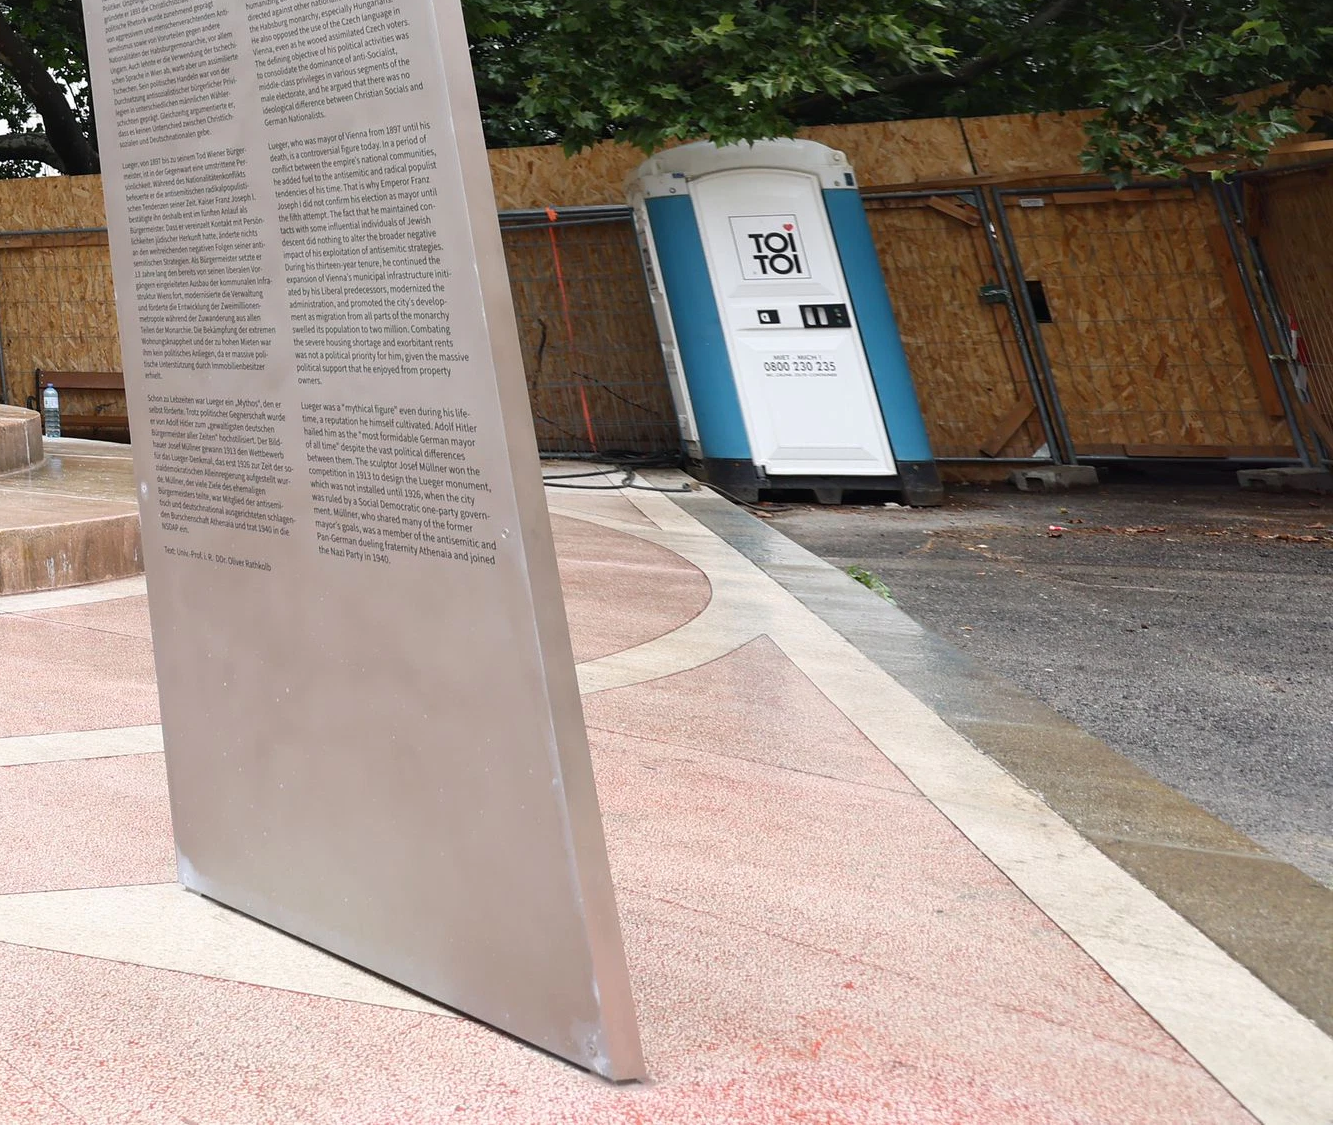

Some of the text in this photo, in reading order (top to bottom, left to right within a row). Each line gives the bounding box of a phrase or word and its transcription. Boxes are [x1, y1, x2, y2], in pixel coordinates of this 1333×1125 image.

[247, 8, 271, 21] directed
[271, 4, 293, 17] against
[293, 1, 310, 11] other
[248, 24, 259, 33] the
[259, 19, 288, 30] Habsburg
[320, 3, 352, 17] especially
[250, 6, 400, 44] He also opposed the use of the Czech language in
[254, 31, 409, 67] The defining objective of his political activities was
[262, 80, 423, 114] ideological difference between Christian Socials and
[271, 164, 293, 173] conflict
[293, 162, 320, 171] between
[321, 159, 332, 168] the
[360, 151, 388, 163] national
[272, 160, 436, 185] he added fuel to the antisemitic and radical populist
[216, 196, 230, 205] Franz
[231, 194, 251, 203] Joseph
[279, 214, 431, 234] tacts with some influential individuals of Jewish
[748, 232, 797, 253] TOI
[753, 254, 802, 274] TOI
[764, 361, 836, 372] 0800 230 235
[308, 467, 347, 477] competition
[347, 469, 355, 478] in
[355, 470, 371, 480] 1913
[371, 472, 380, 481] to
[380, 472, 404, 484] design
[404, 474, 418, 484] the
[418, 476, 444, 488] Lueger
[325, 494, 342, 503] ruled
[342, 495, 352, 506] by
[357, 497, 379, 508] Social
[379, 499, 420, 512] Democratic
